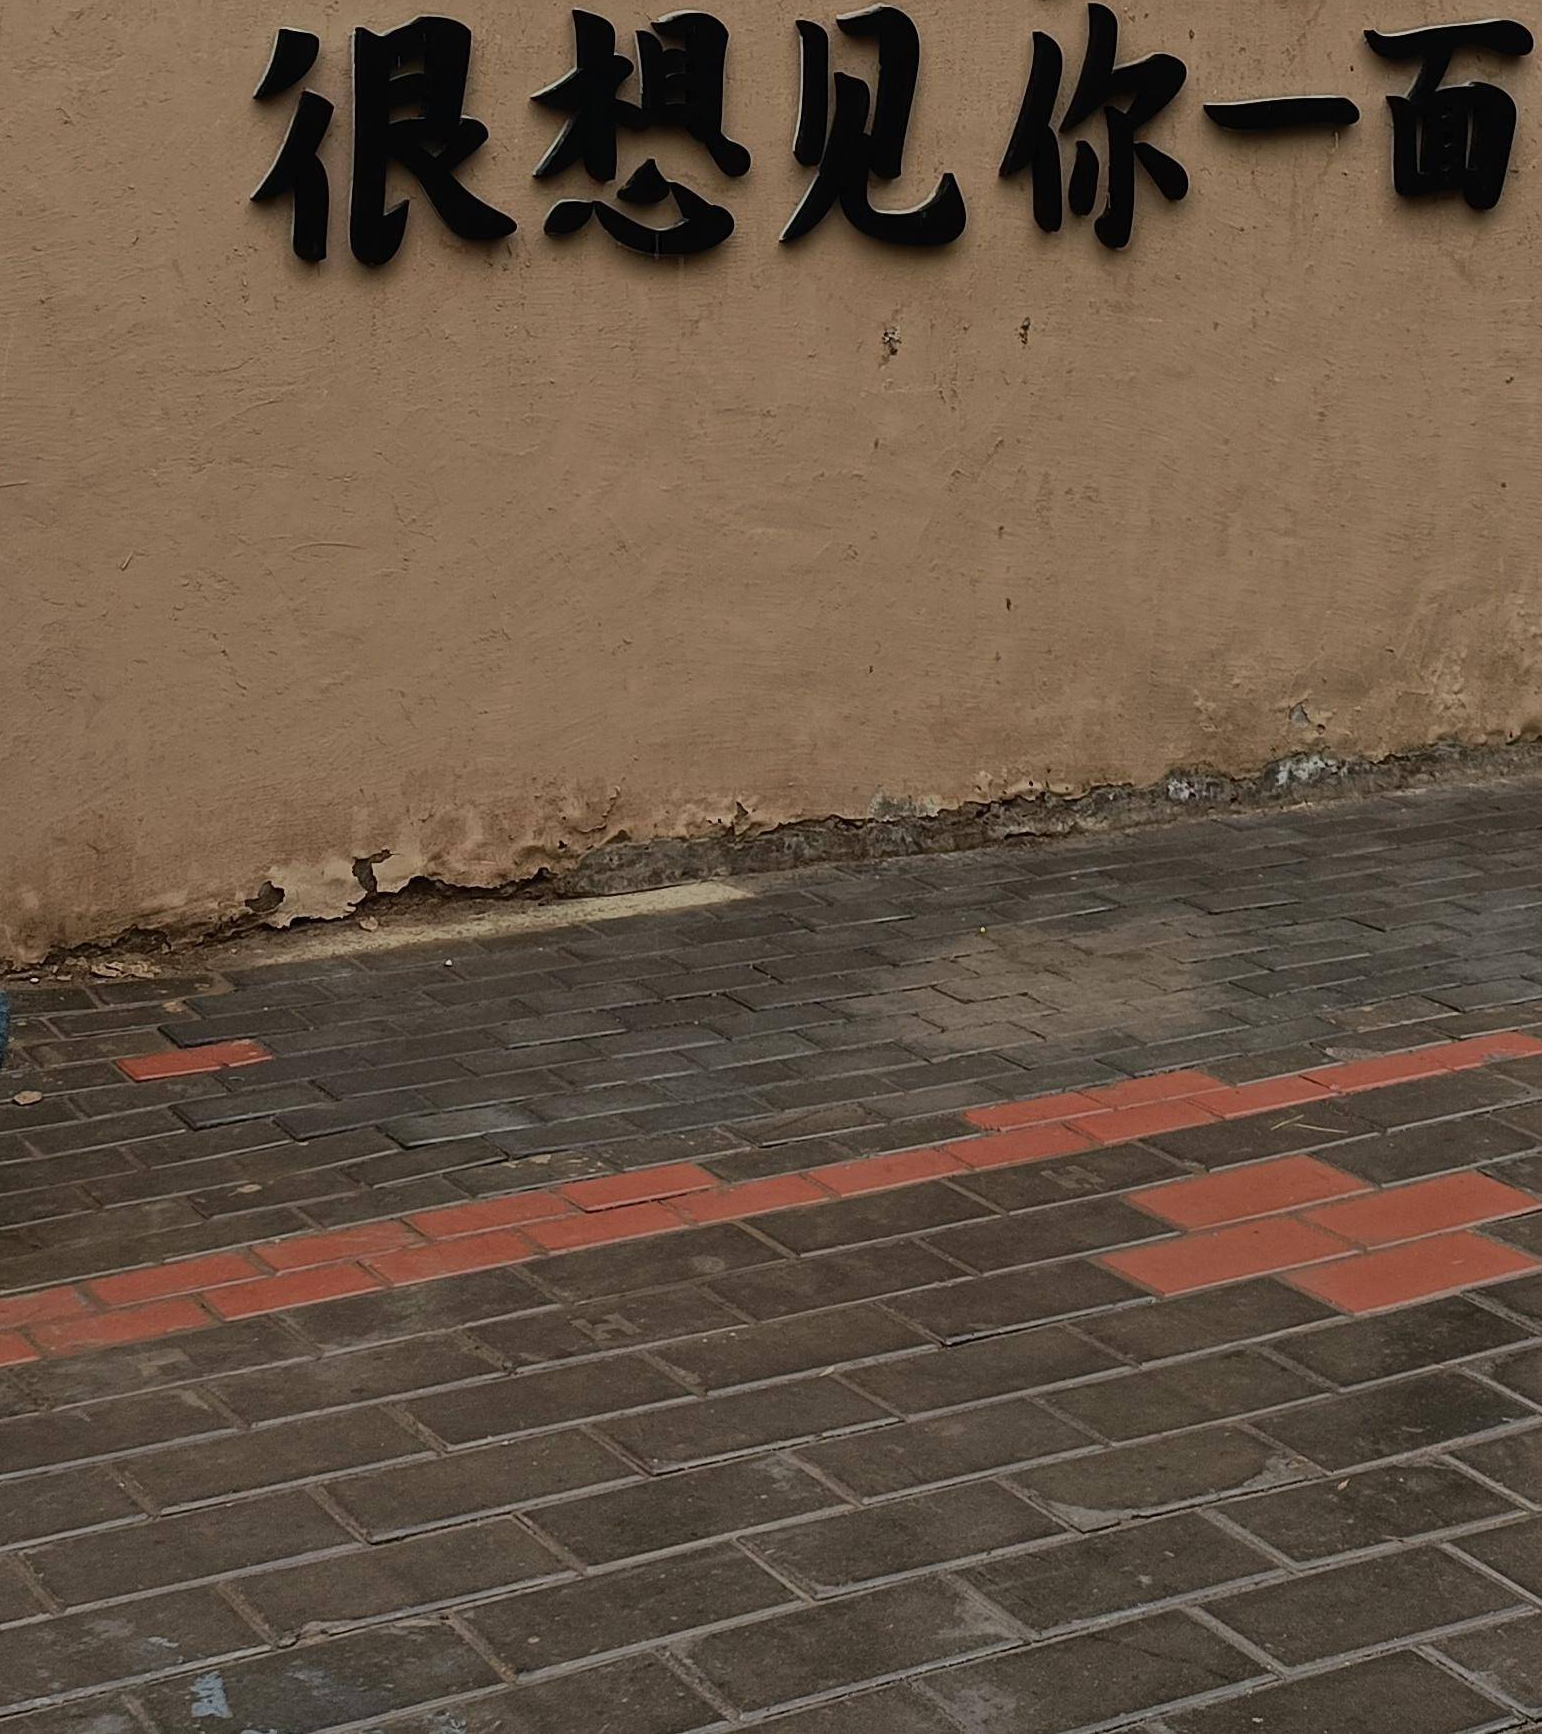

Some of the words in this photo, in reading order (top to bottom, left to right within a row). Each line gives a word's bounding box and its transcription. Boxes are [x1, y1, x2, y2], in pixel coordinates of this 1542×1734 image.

[248, 2, 1535, 269] 很想见你一面
